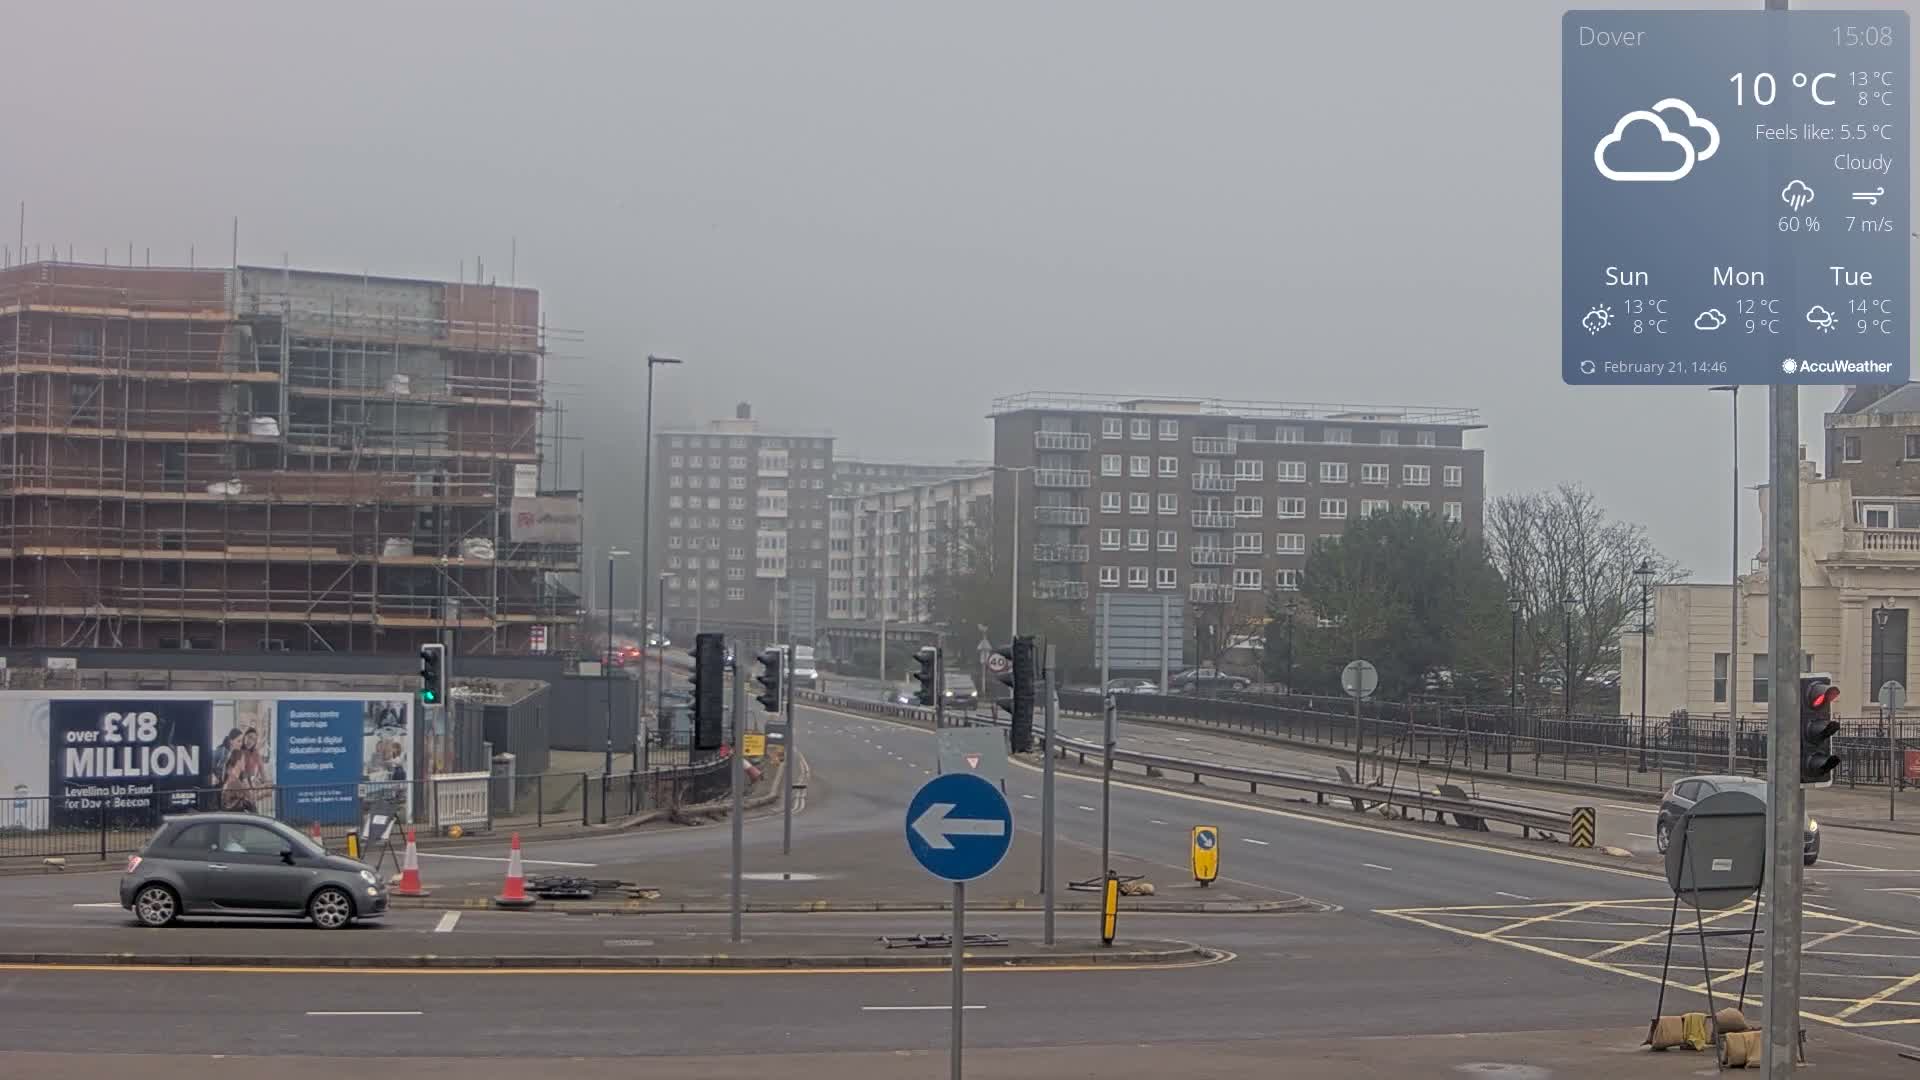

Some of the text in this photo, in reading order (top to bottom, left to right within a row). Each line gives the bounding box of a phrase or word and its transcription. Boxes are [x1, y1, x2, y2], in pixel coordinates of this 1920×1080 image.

[991, 657, 1005, 667] 40
[66, 711, 159, 743] over £18
[66, 745, 200, 778] MILLION
[128, 783, 153, 795] Fund
[65, 798, 79, 809] for
